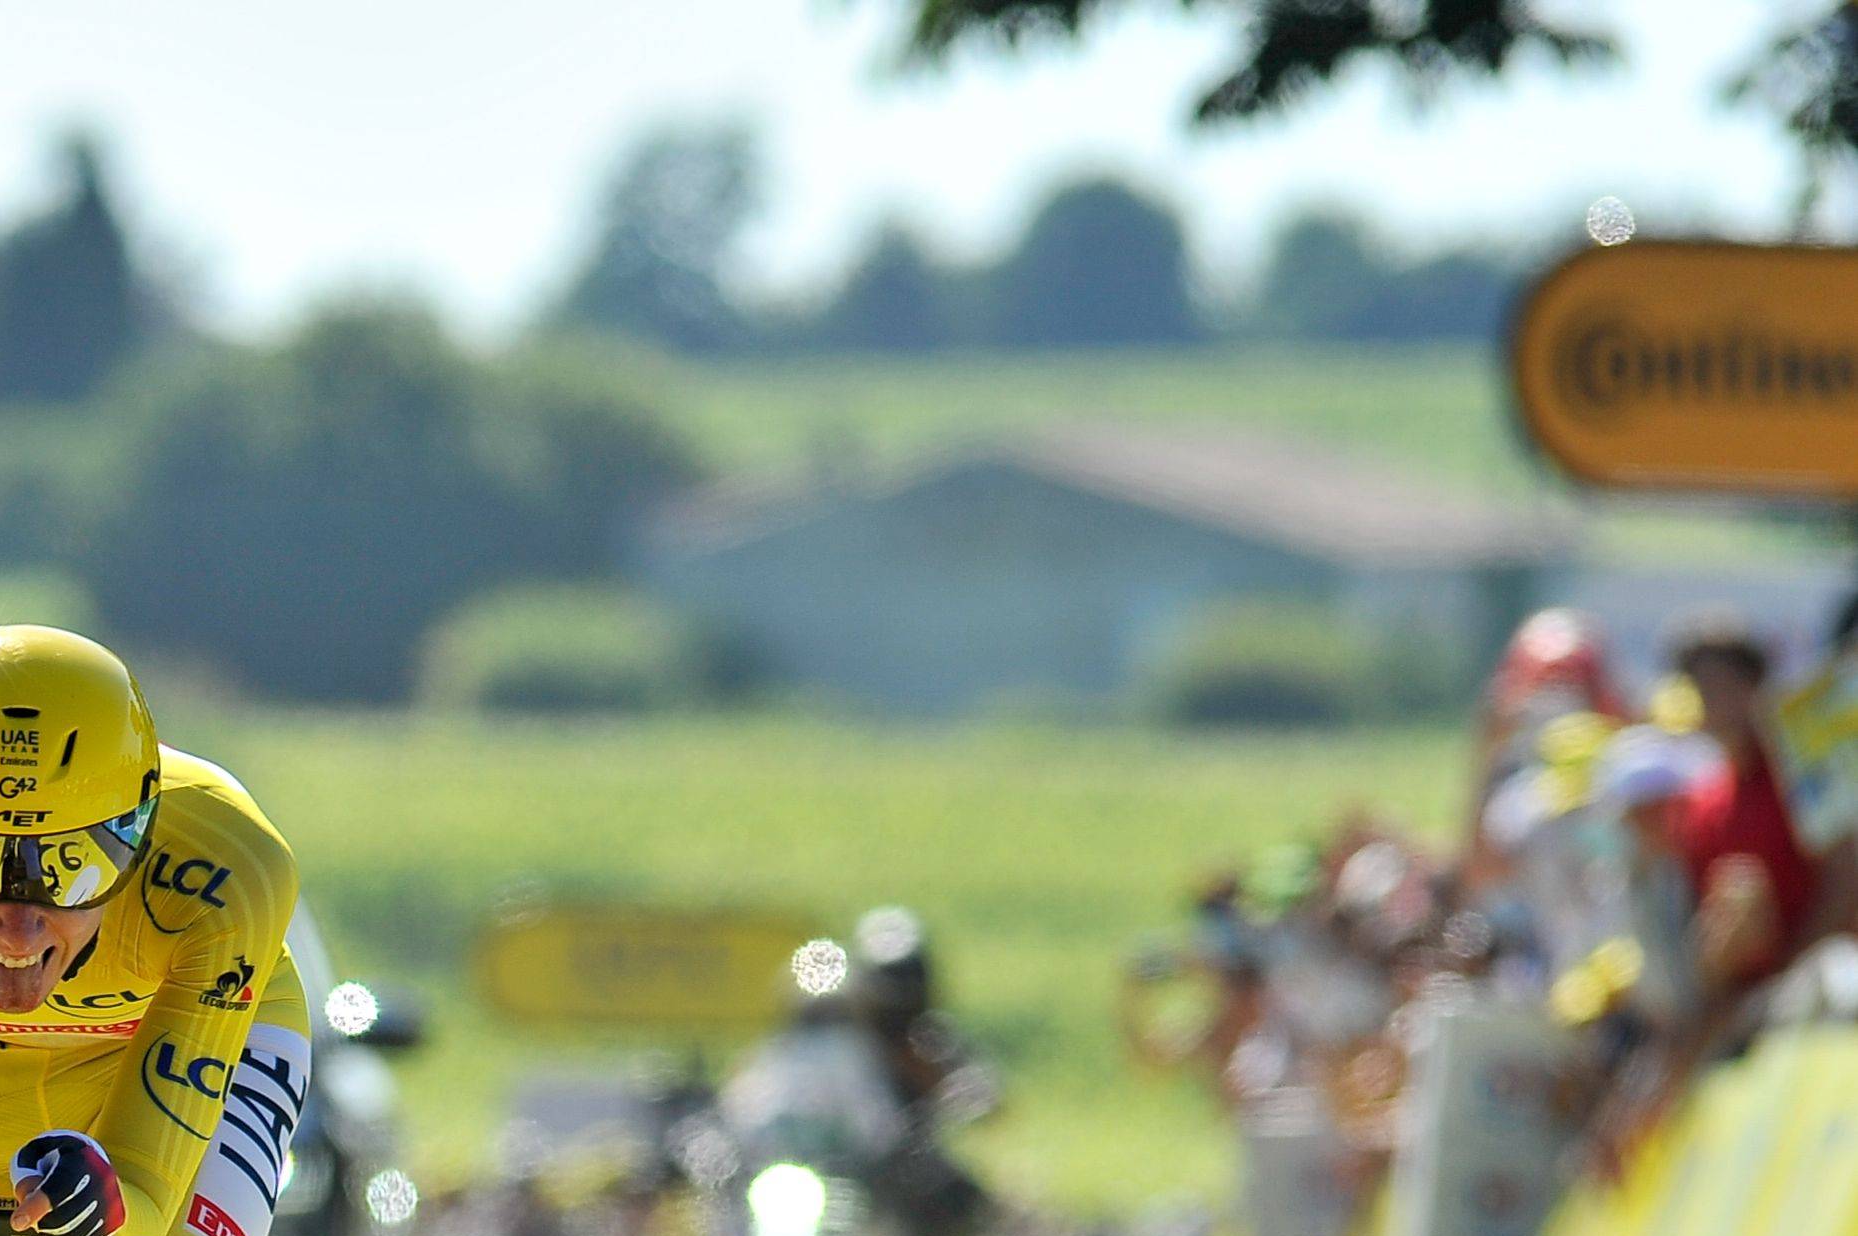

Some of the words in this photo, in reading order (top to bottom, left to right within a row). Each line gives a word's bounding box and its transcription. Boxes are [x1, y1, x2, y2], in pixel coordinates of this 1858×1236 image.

[1, 729, 40, 746] UAE
[150, 852, 233, 909] LCL
[52, 989, 156, 1009] LCL
